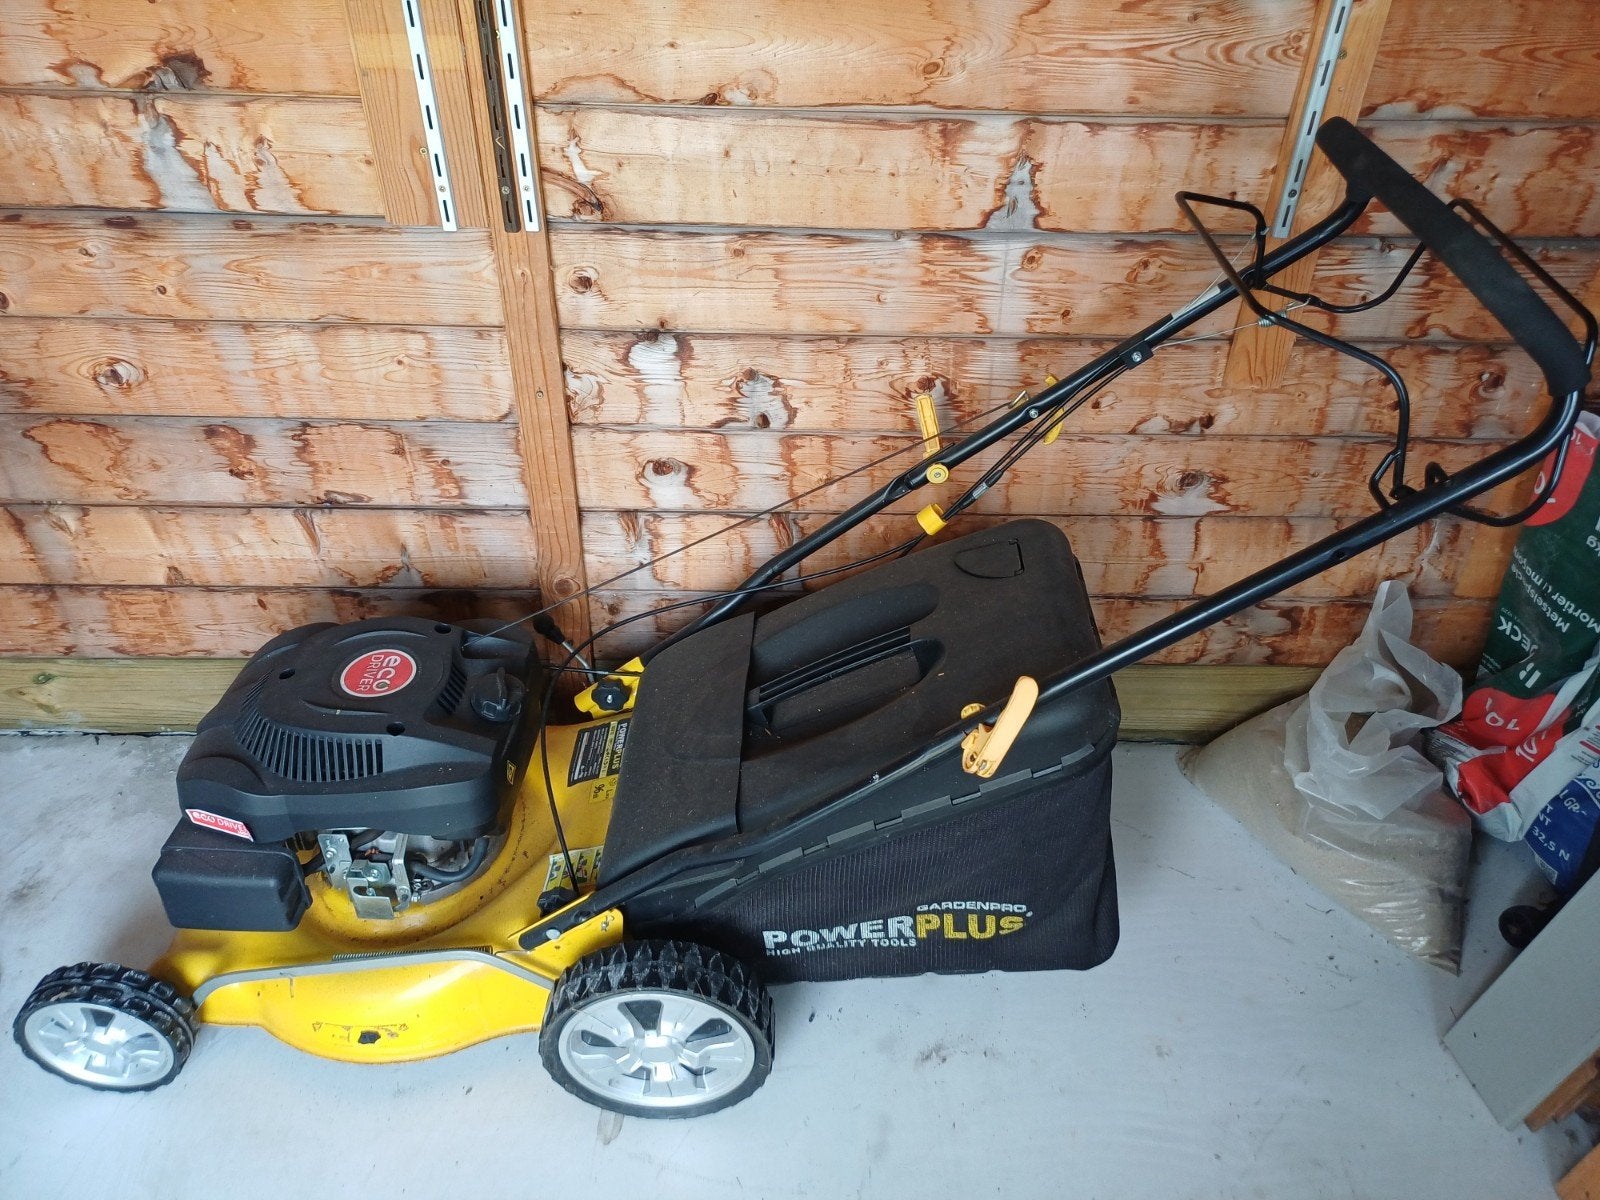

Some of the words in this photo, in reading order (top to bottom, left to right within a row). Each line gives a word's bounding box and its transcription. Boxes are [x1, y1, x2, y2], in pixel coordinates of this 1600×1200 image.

[1551, 592, 1600, 634] Mortier
[356, 654, 384, 691] DRIVER
[1558, 848, 1570, 861] N
[917, 901, 1027, 913] GARDENPRO
[762, 913, 1025, 949] POWERPLUS
[766, 946, 801, 956] HIGH
[870, 937, 917, 948] TOOLS
